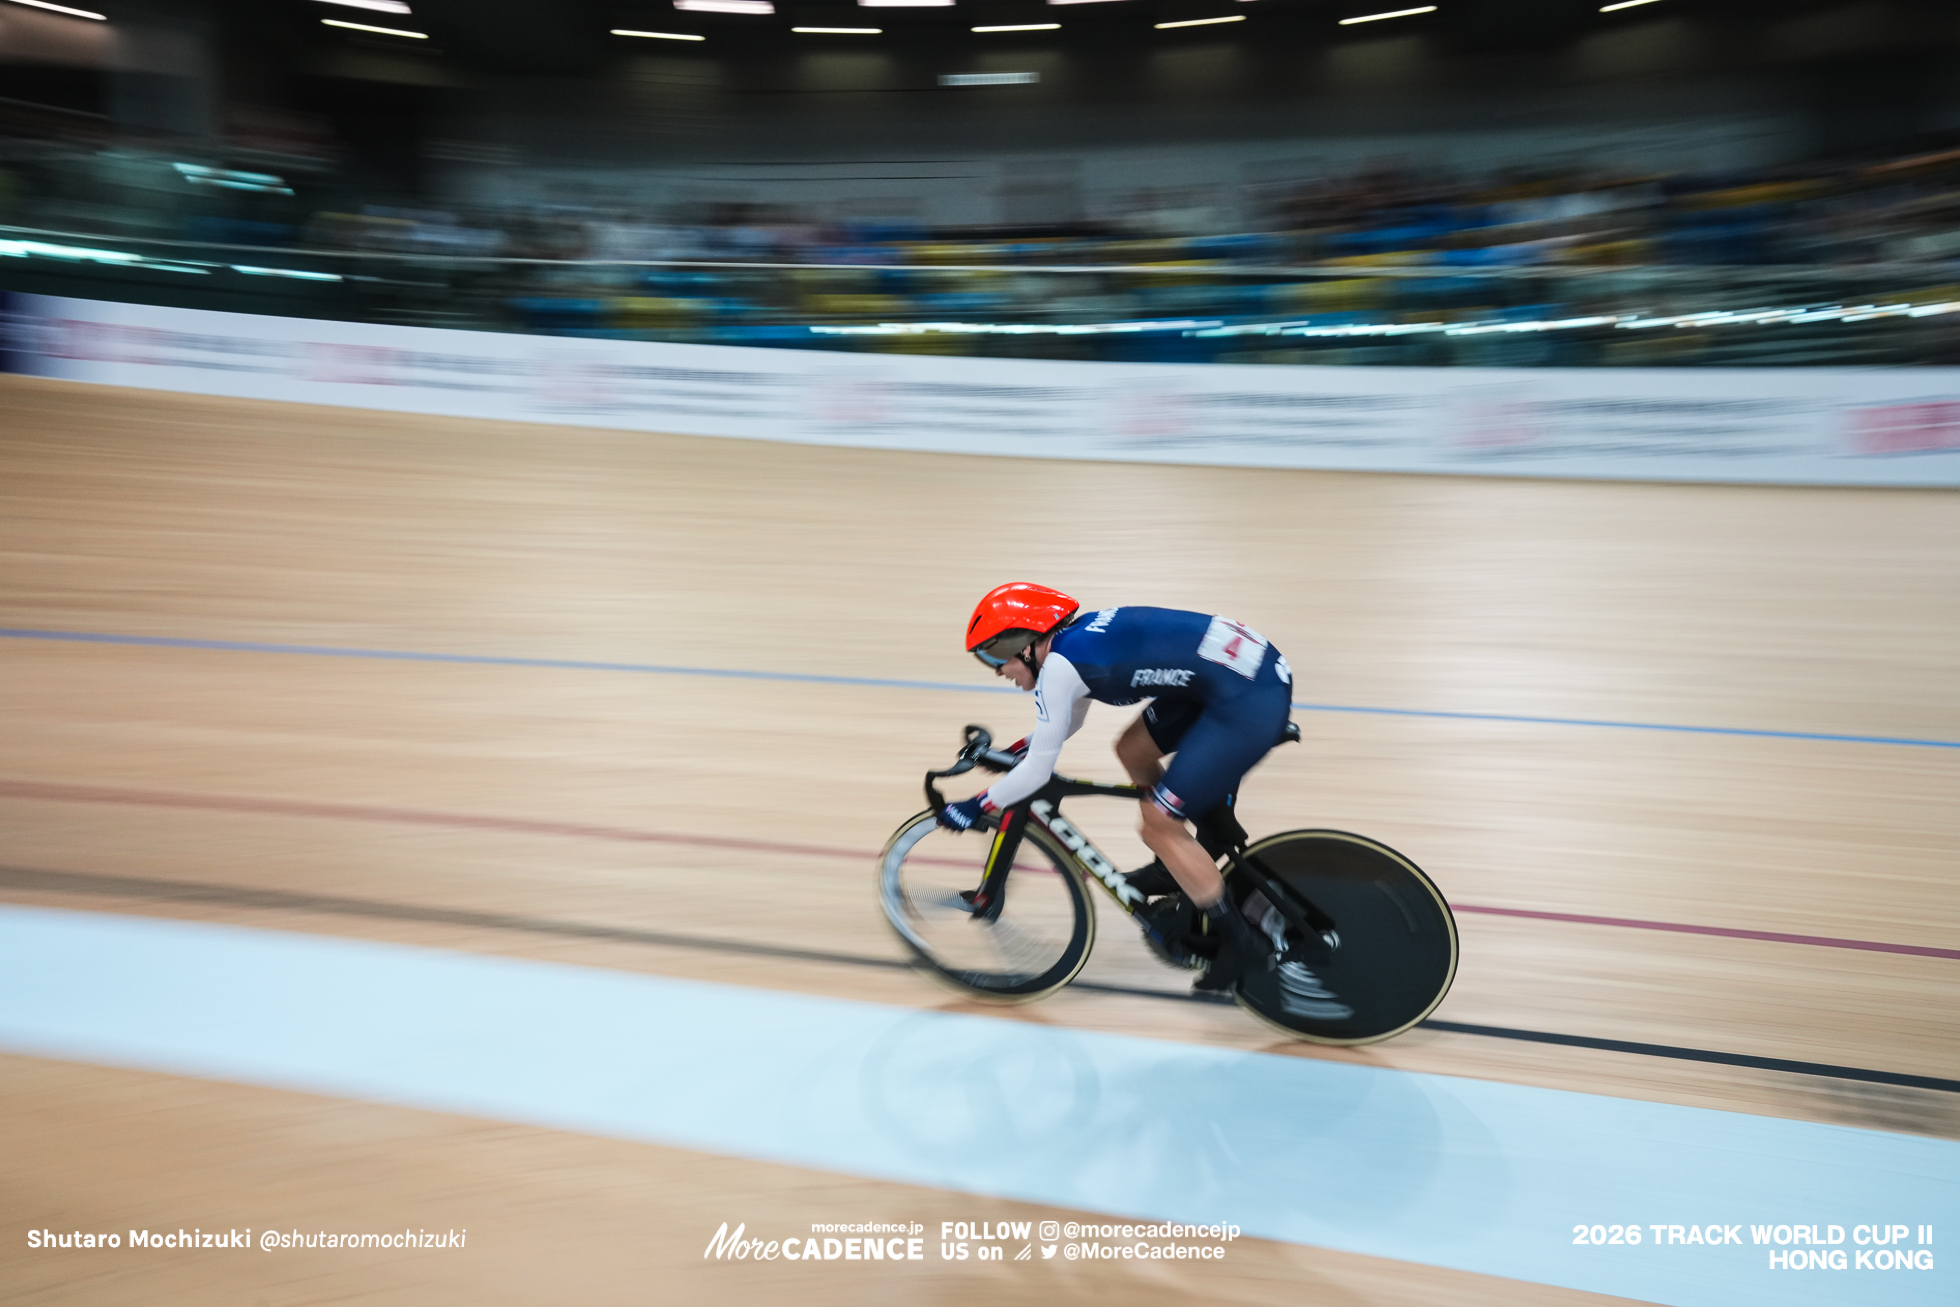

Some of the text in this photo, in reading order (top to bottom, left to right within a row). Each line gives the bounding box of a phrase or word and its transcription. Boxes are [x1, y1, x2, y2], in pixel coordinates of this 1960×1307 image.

[1223, 634, 1243, 662] 4
[1129, 668, 1196, 688] FRANCE
[1029, 799, 1146, 907] LOOK
